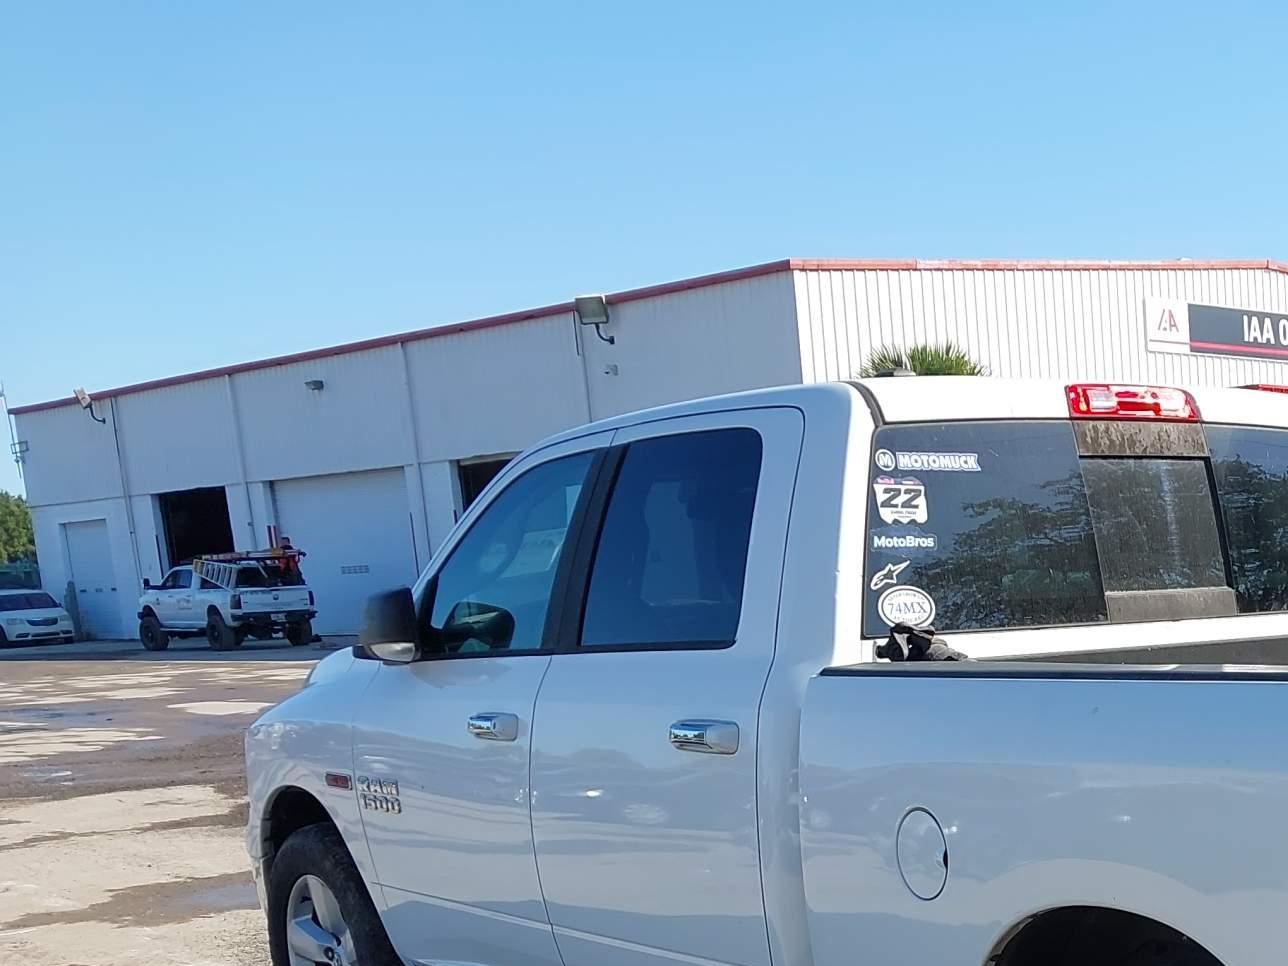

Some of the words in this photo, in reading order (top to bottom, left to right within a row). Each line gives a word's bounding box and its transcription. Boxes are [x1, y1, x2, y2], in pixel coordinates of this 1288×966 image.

[1242, 314, 1276, 346] IAA
[897, 453, 979, 470] MOTOMUCK
[879, 487, 923, 509] 22
[873, 535, 936, 549] MotoBros
[887, 600, 929, 616] 74MX
[357, 775, 400, 797] RAM
